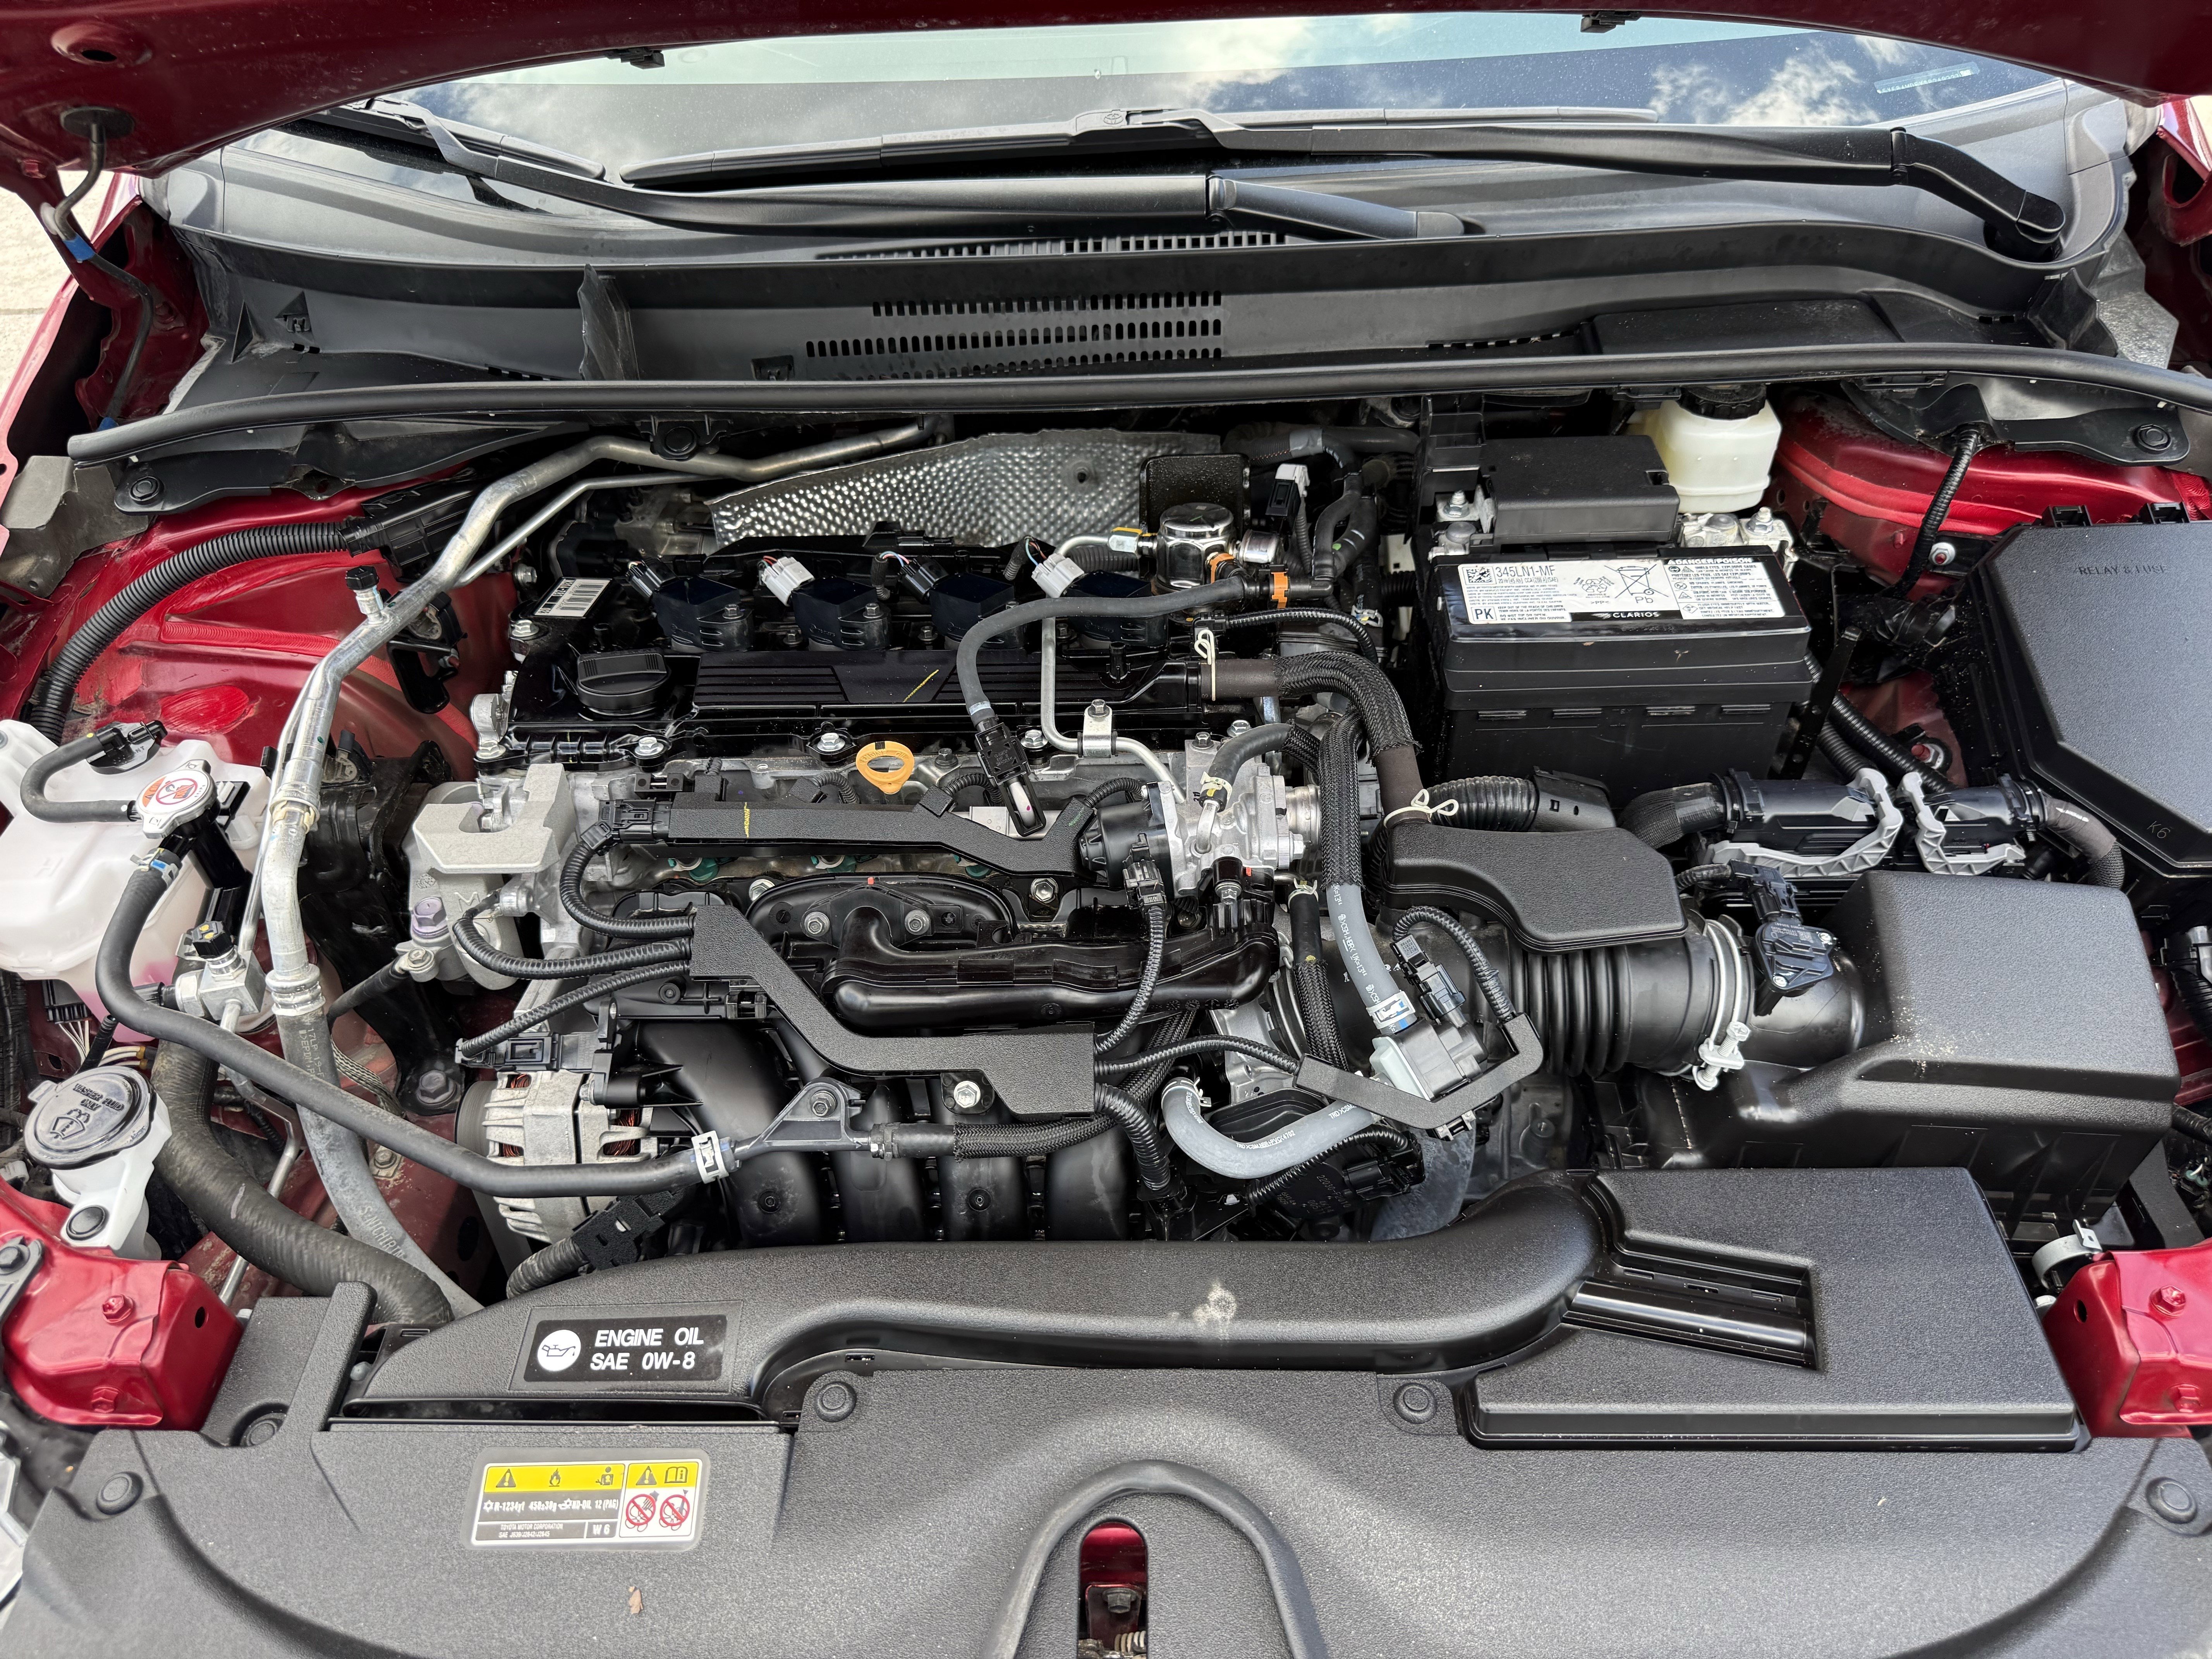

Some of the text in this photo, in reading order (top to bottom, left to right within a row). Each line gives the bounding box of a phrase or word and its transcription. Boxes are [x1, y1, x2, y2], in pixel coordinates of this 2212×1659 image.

[1496, 565, 1555, 577] 345LN1-MF
[2078, 565, 2118, 575] RELAY
[1475, 608, 1494, 620] PK
[860, 749, 887, 762] ENGINE
[2147, 821, 2171, 838] K6
[72, 1083, 125, 1111] WASHER FLUID
[80, 1099, 102, 1111] ONLY
[594, 1327, 704, 1347] ENGINE OIL
[589, 1351, 696, 1370] SAE 0W-8
[494, 1501, 525, 1513] R-1234yf
[572, 1500, 592, 1509] ND-OIL
[595, 1500, 603, 1509] 12
[603, 1499, 619, 1510] (PAG)
